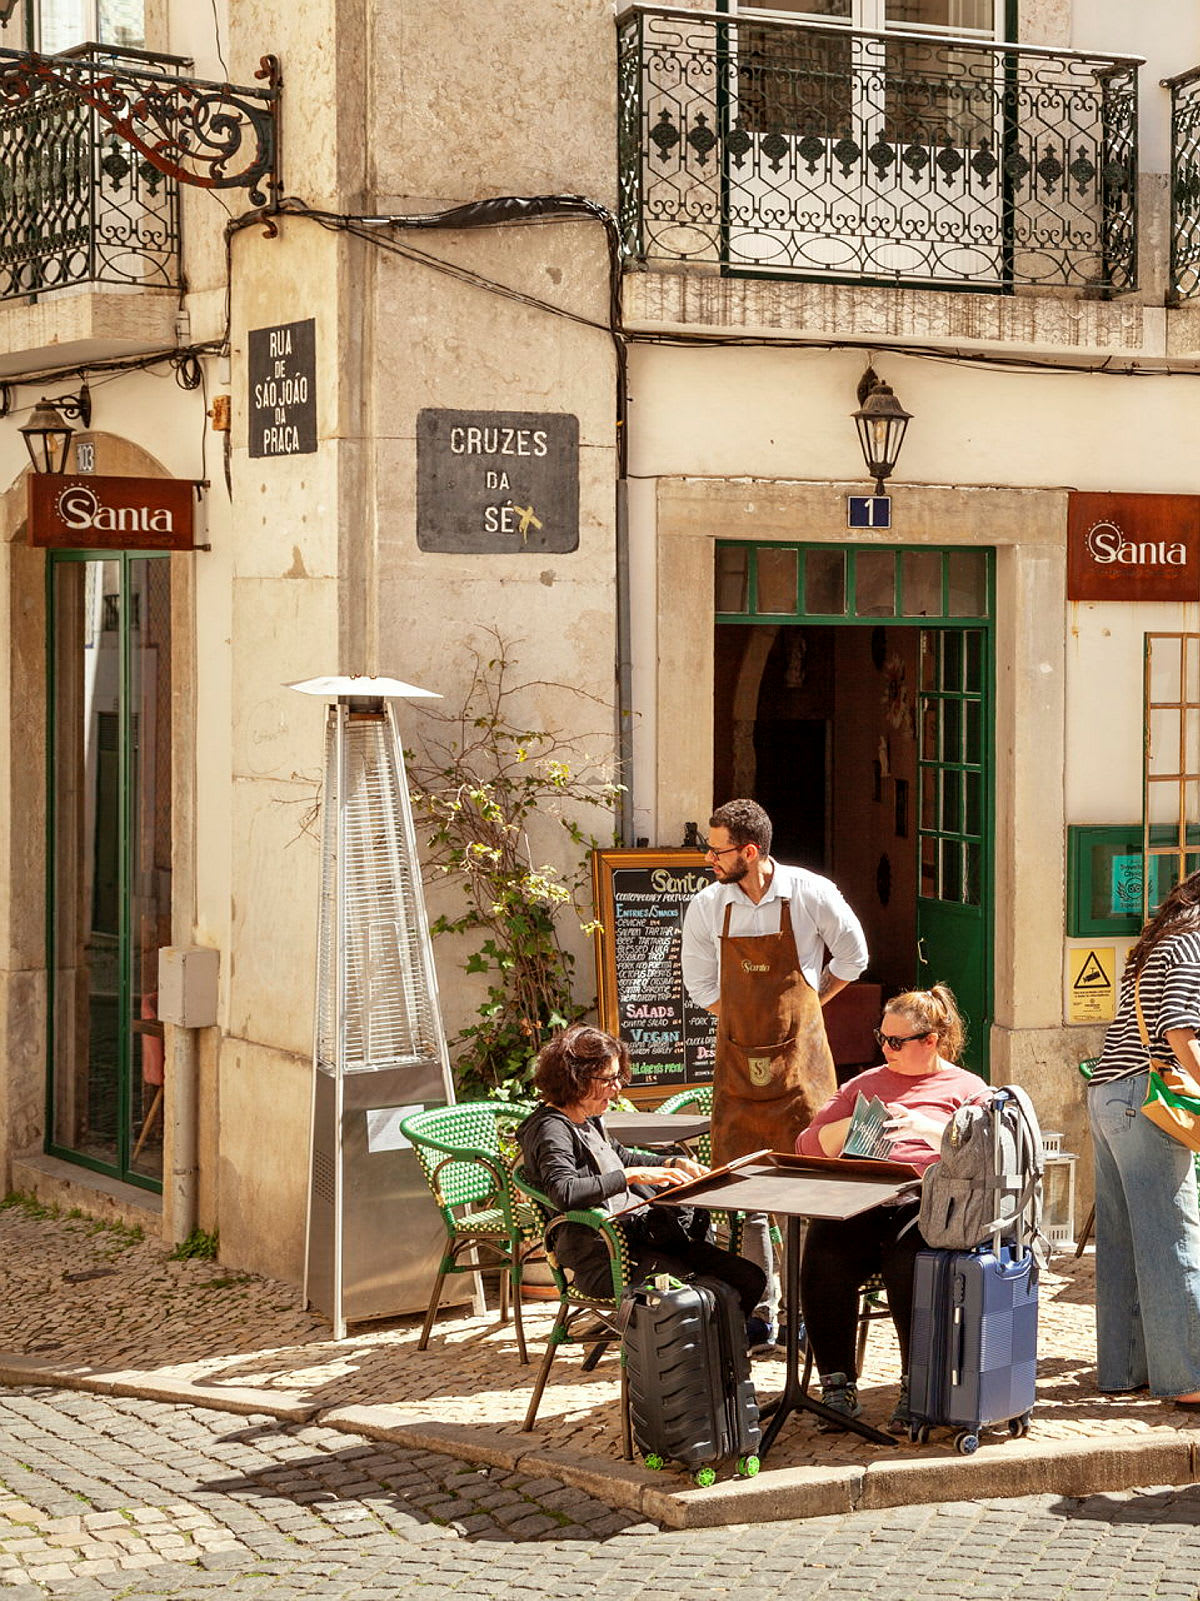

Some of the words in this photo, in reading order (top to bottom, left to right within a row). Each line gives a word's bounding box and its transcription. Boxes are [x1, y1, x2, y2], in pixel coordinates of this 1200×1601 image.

[270, 329, 292, 358] RUA
[274, 360, 286, 379] DE
[274, 407, 286, 425] DA
[263, 425, 300, 455] PRAÇA
[450, 427, 548, 457] CRUZES
[486, 471, 510, 490] DA
[58, 486, 173, 532] Santa
[484, 500, 515, 533] SÉ
[864, 498, 874, 526] 1
[1088, 523, 1187, 565] Santa
[630, 1028, 680, 1043] VEGAN
